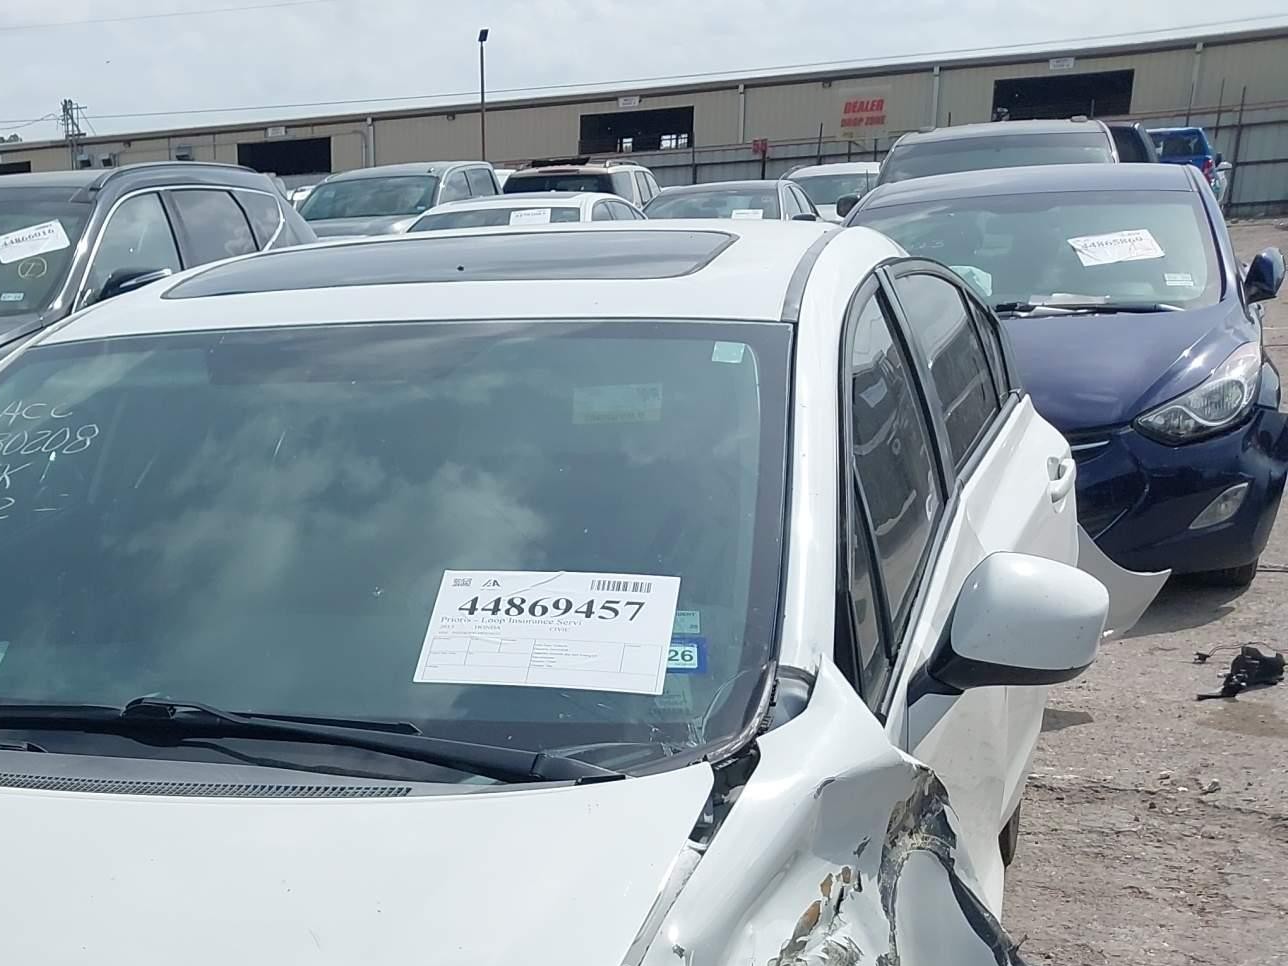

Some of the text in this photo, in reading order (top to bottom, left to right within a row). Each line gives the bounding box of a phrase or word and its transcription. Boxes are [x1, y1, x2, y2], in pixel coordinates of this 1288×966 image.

[843, 99, 884, 114] DEALER
[458, 596, 645, 622] 44869457
[668, 649, 694, 662] 26
